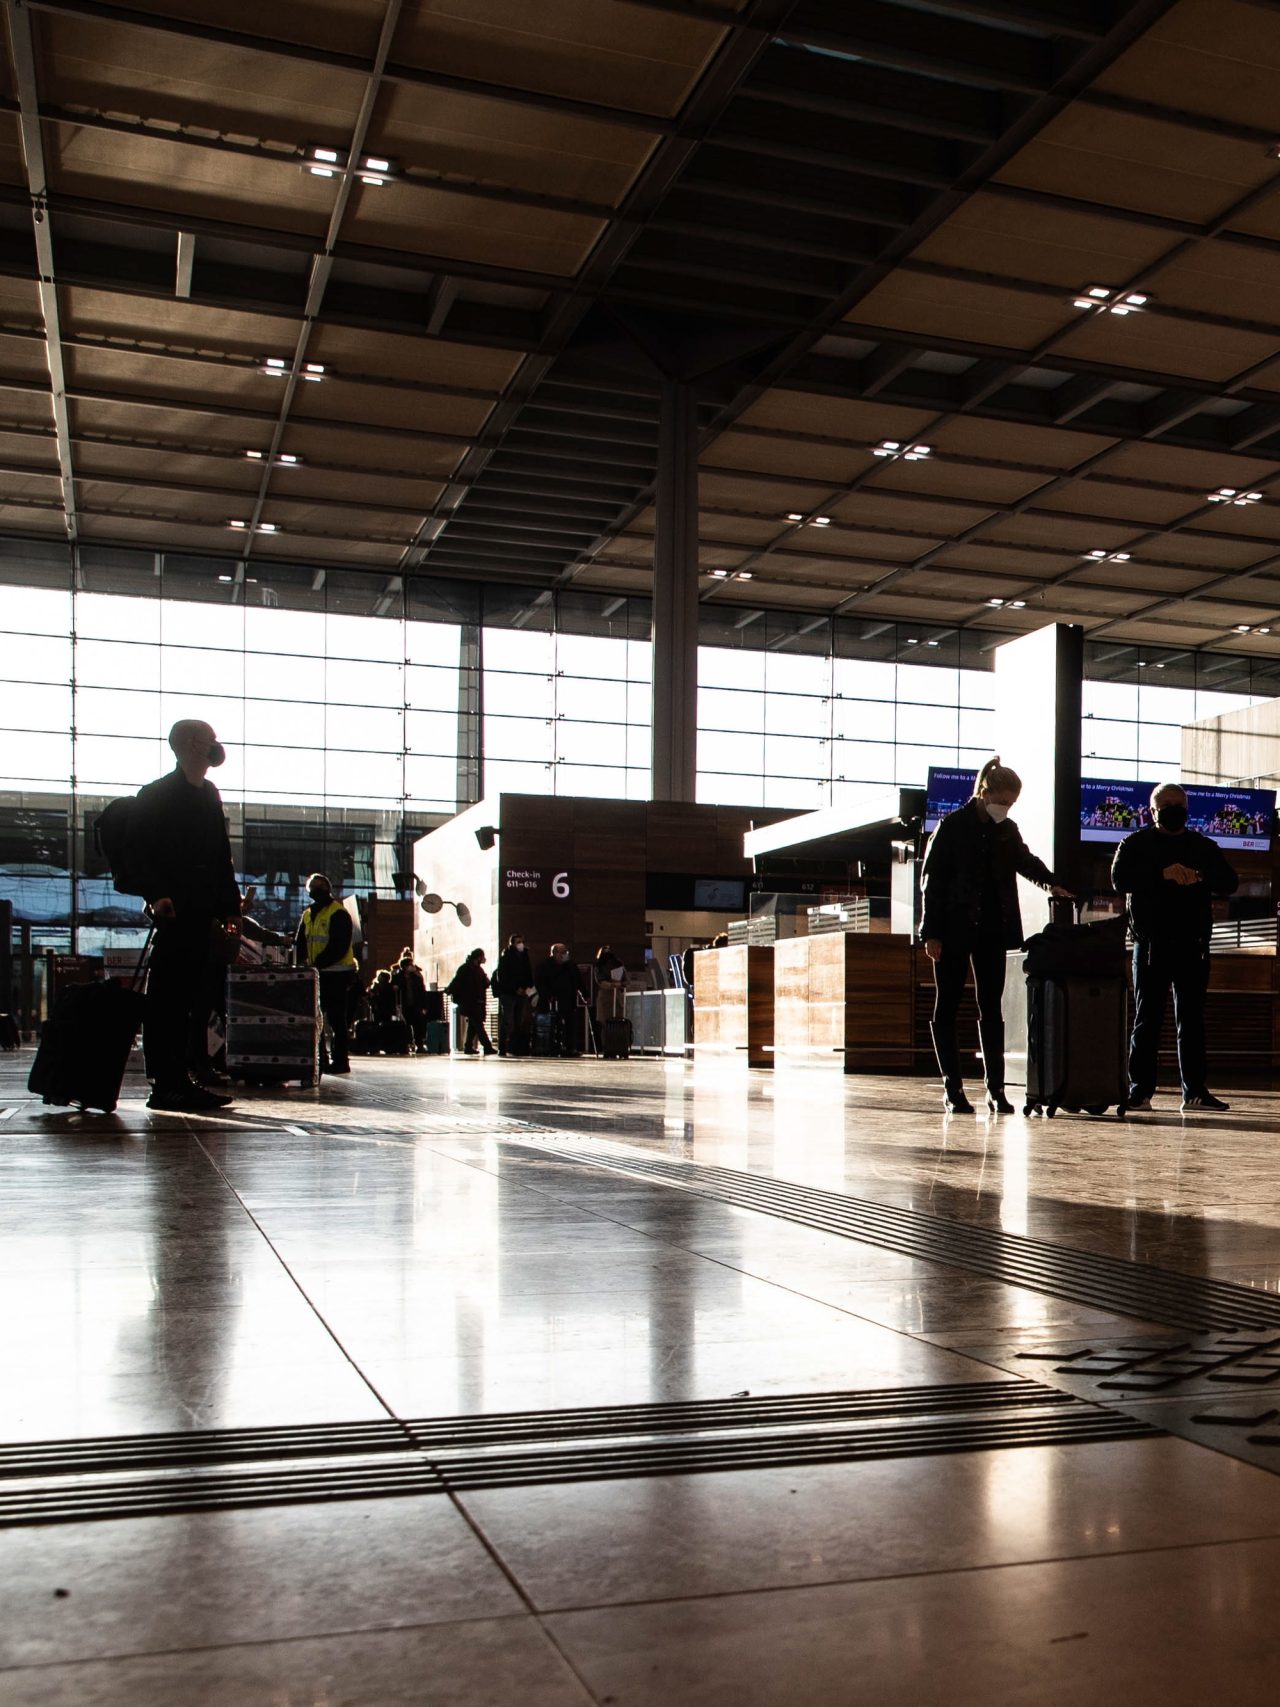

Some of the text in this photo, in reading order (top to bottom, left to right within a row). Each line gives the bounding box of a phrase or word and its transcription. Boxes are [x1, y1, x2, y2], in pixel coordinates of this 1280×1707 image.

[933, 772, 950, 780] Follow
[1096, 784, 1110, 792] Merry
[1215, 792, 1229, 800] Merry
[506, 870, 541, 879] Check-in
[552, 872, 570, 898] 6
